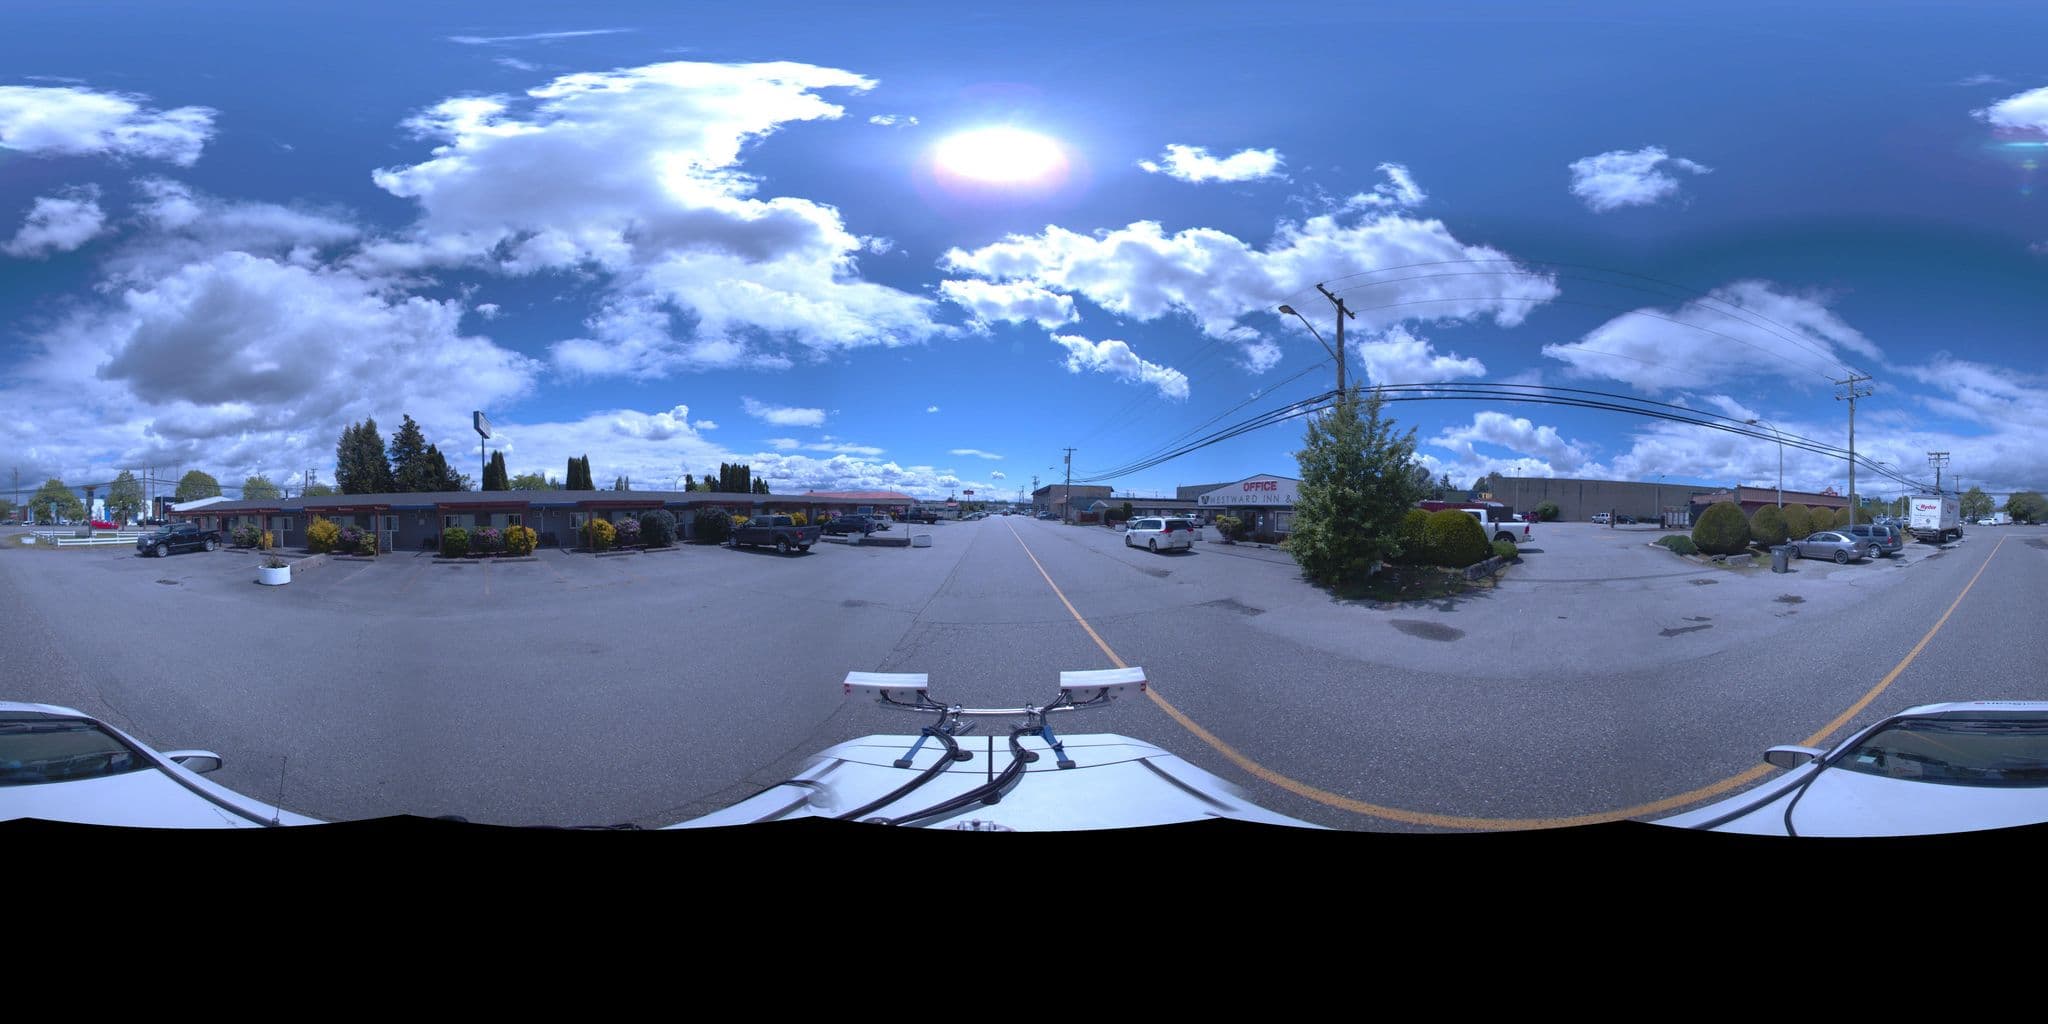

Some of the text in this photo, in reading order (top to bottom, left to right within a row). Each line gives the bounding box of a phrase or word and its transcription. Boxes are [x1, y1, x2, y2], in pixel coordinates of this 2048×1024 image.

[1243, 482, 1278, 491] OFFICE
[1210, 495, 1258, 504] WESTWARD
[1263, 494, 1280, 504] INN
[1285, 494, 1292, 503] &
